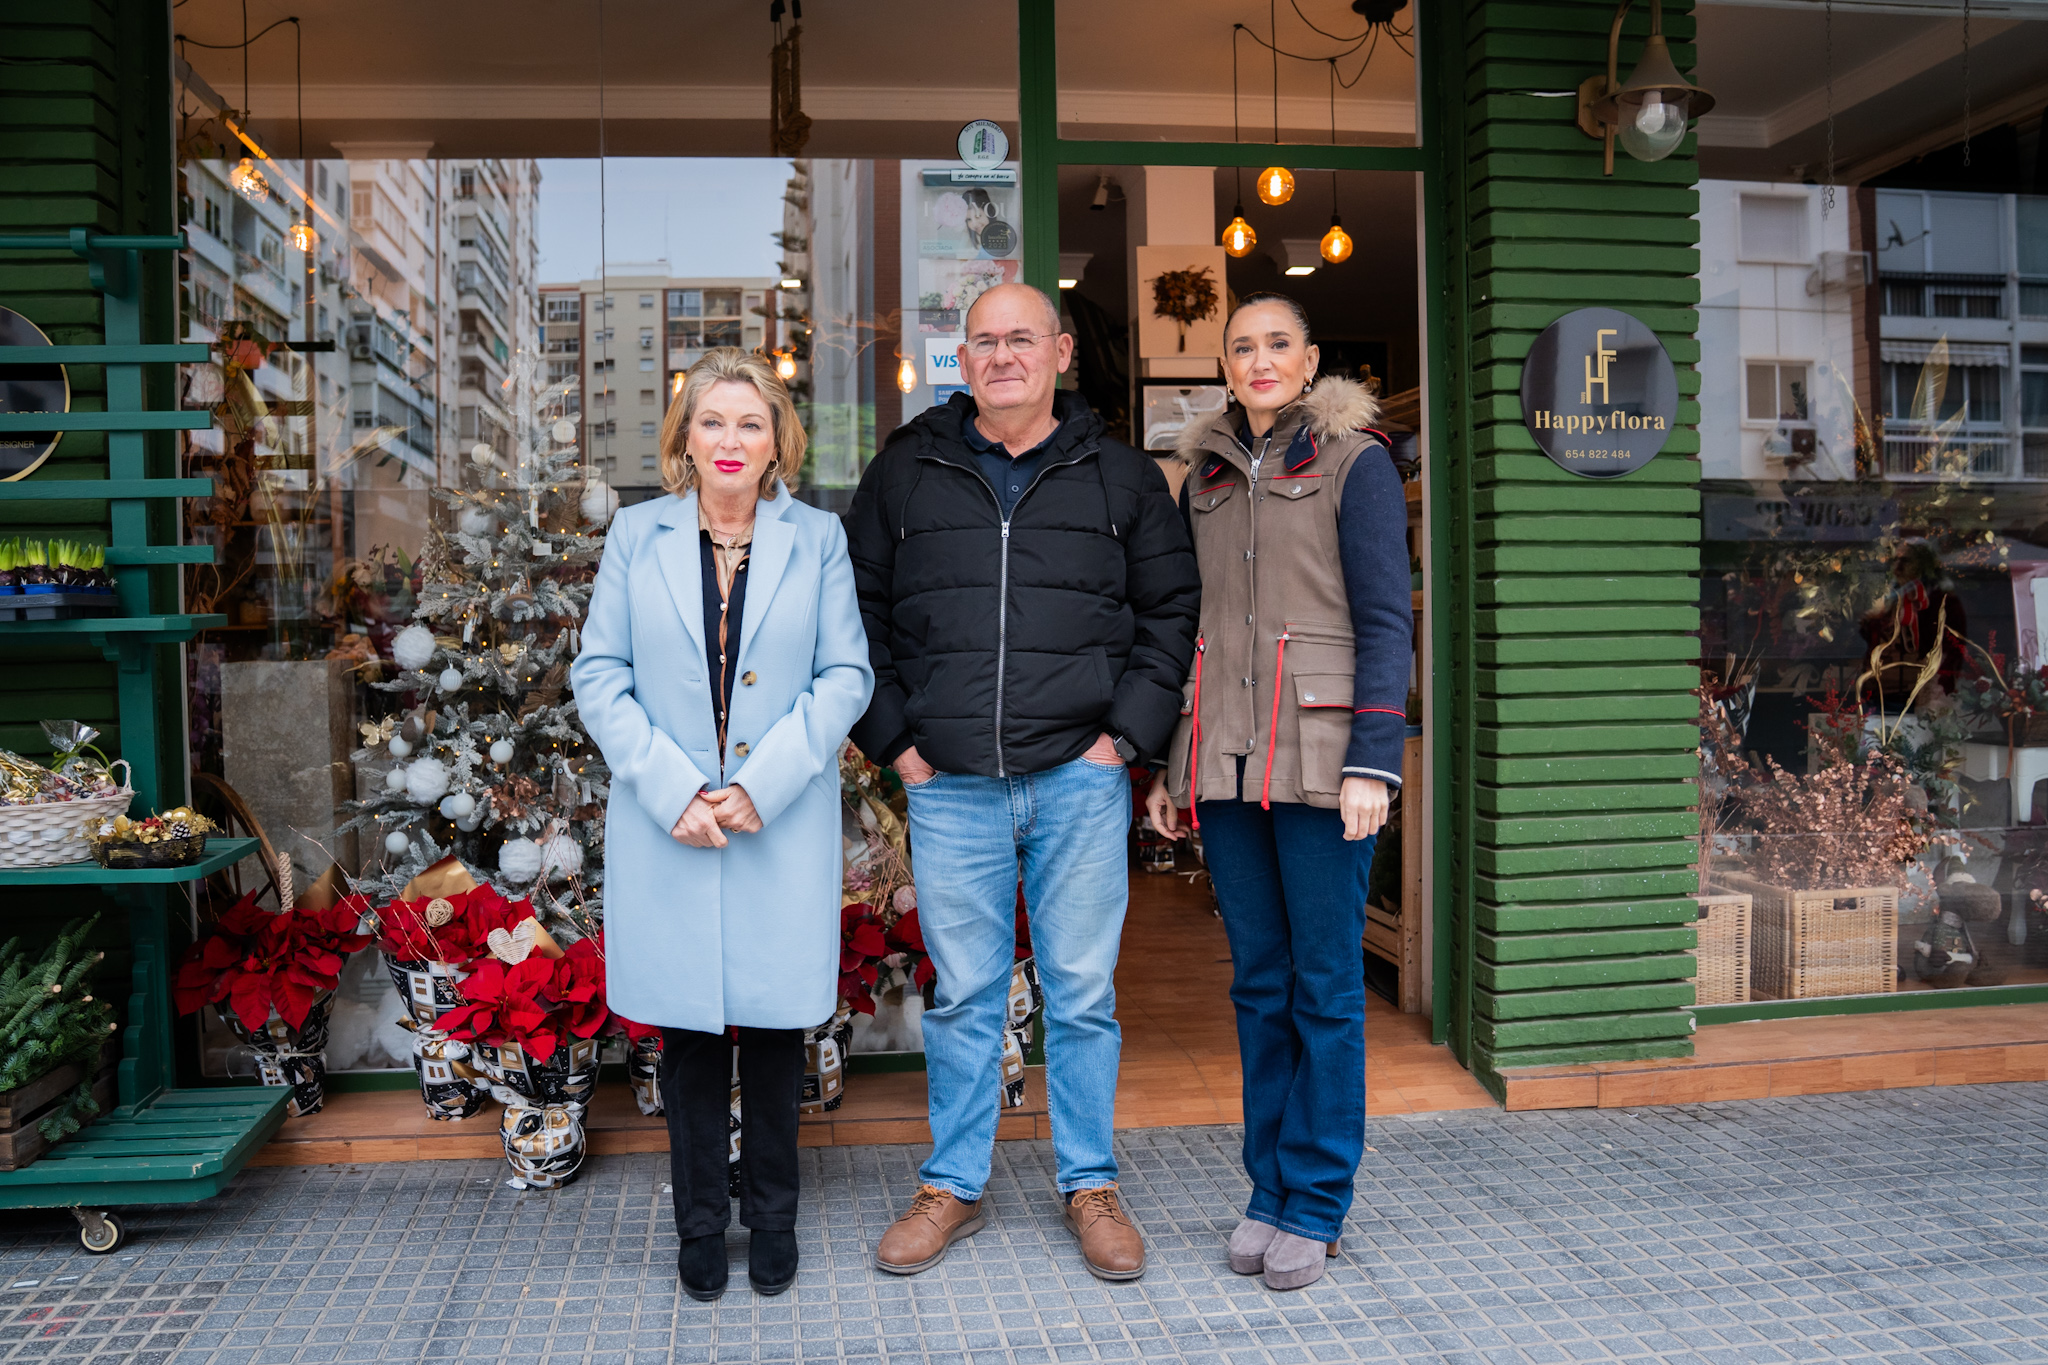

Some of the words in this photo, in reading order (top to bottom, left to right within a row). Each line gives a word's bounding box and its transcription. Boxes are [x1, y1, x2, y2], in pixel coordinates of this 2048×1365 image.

[964, 124, 974, 133] SOY
[975, 121, 1002, 133] MIEMBRO
[930, 355, 960, 367] VIS
[1534, 410, 1666, 435] Happyflora
[1565, 449, 1585, 459] 654
[1588, 449, 1608, 459] 822
[1611, 449, 1631, 459] 484
